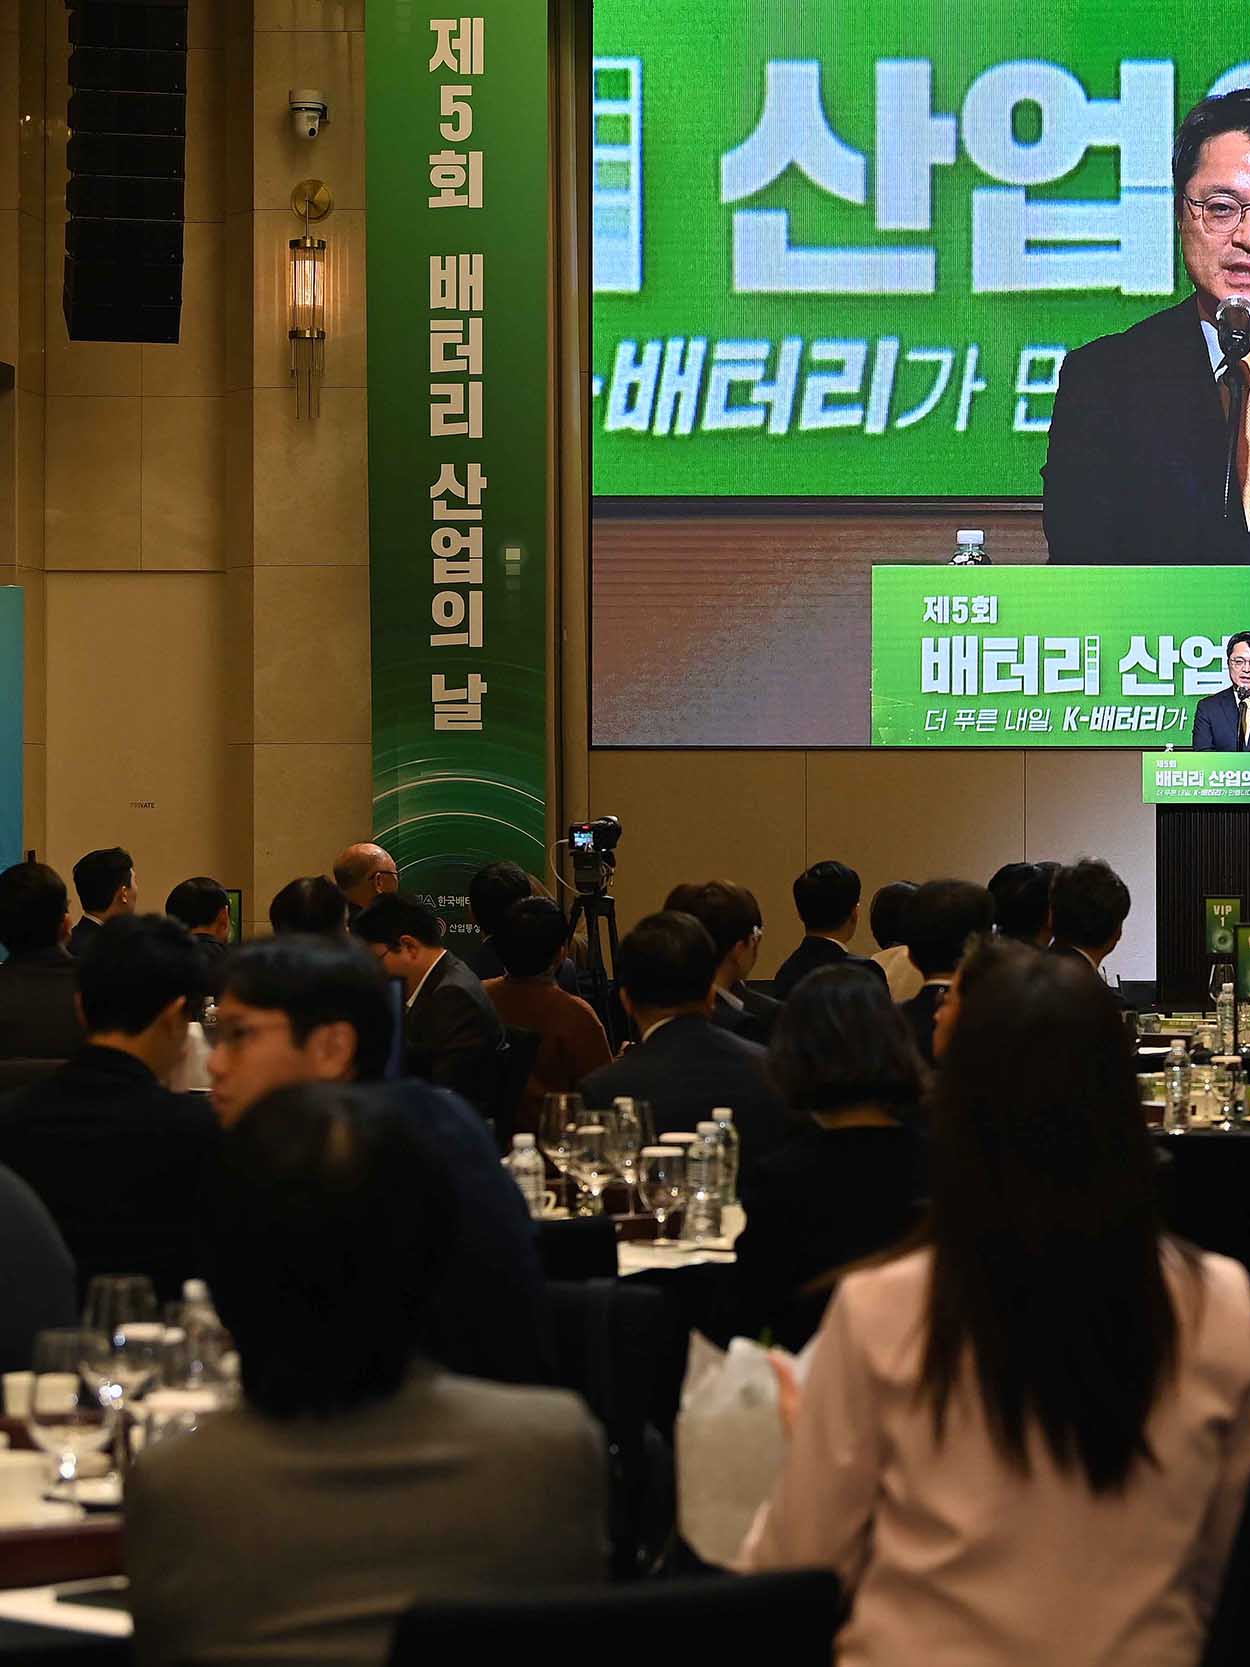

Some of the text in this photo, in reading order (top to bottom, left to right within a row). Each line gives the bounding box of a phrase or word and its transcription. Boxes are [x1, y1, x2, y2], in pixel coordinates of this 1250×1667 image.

[428, 17, 488, 732] 제5회 배터리 산업의 날
[593, 335, 988, 437] 배터리가
[924, 595, 999, 625] 제5회
[921, 635, 1101, 697] 배터리
[924, 705, 1189, 735] 더 푸른 내일, K-배터리가
[1156, 770, 1204, 787] 배터리
[1213, 904, 1232, 915] VIP
[1220, 916, 1225, 927] 1
